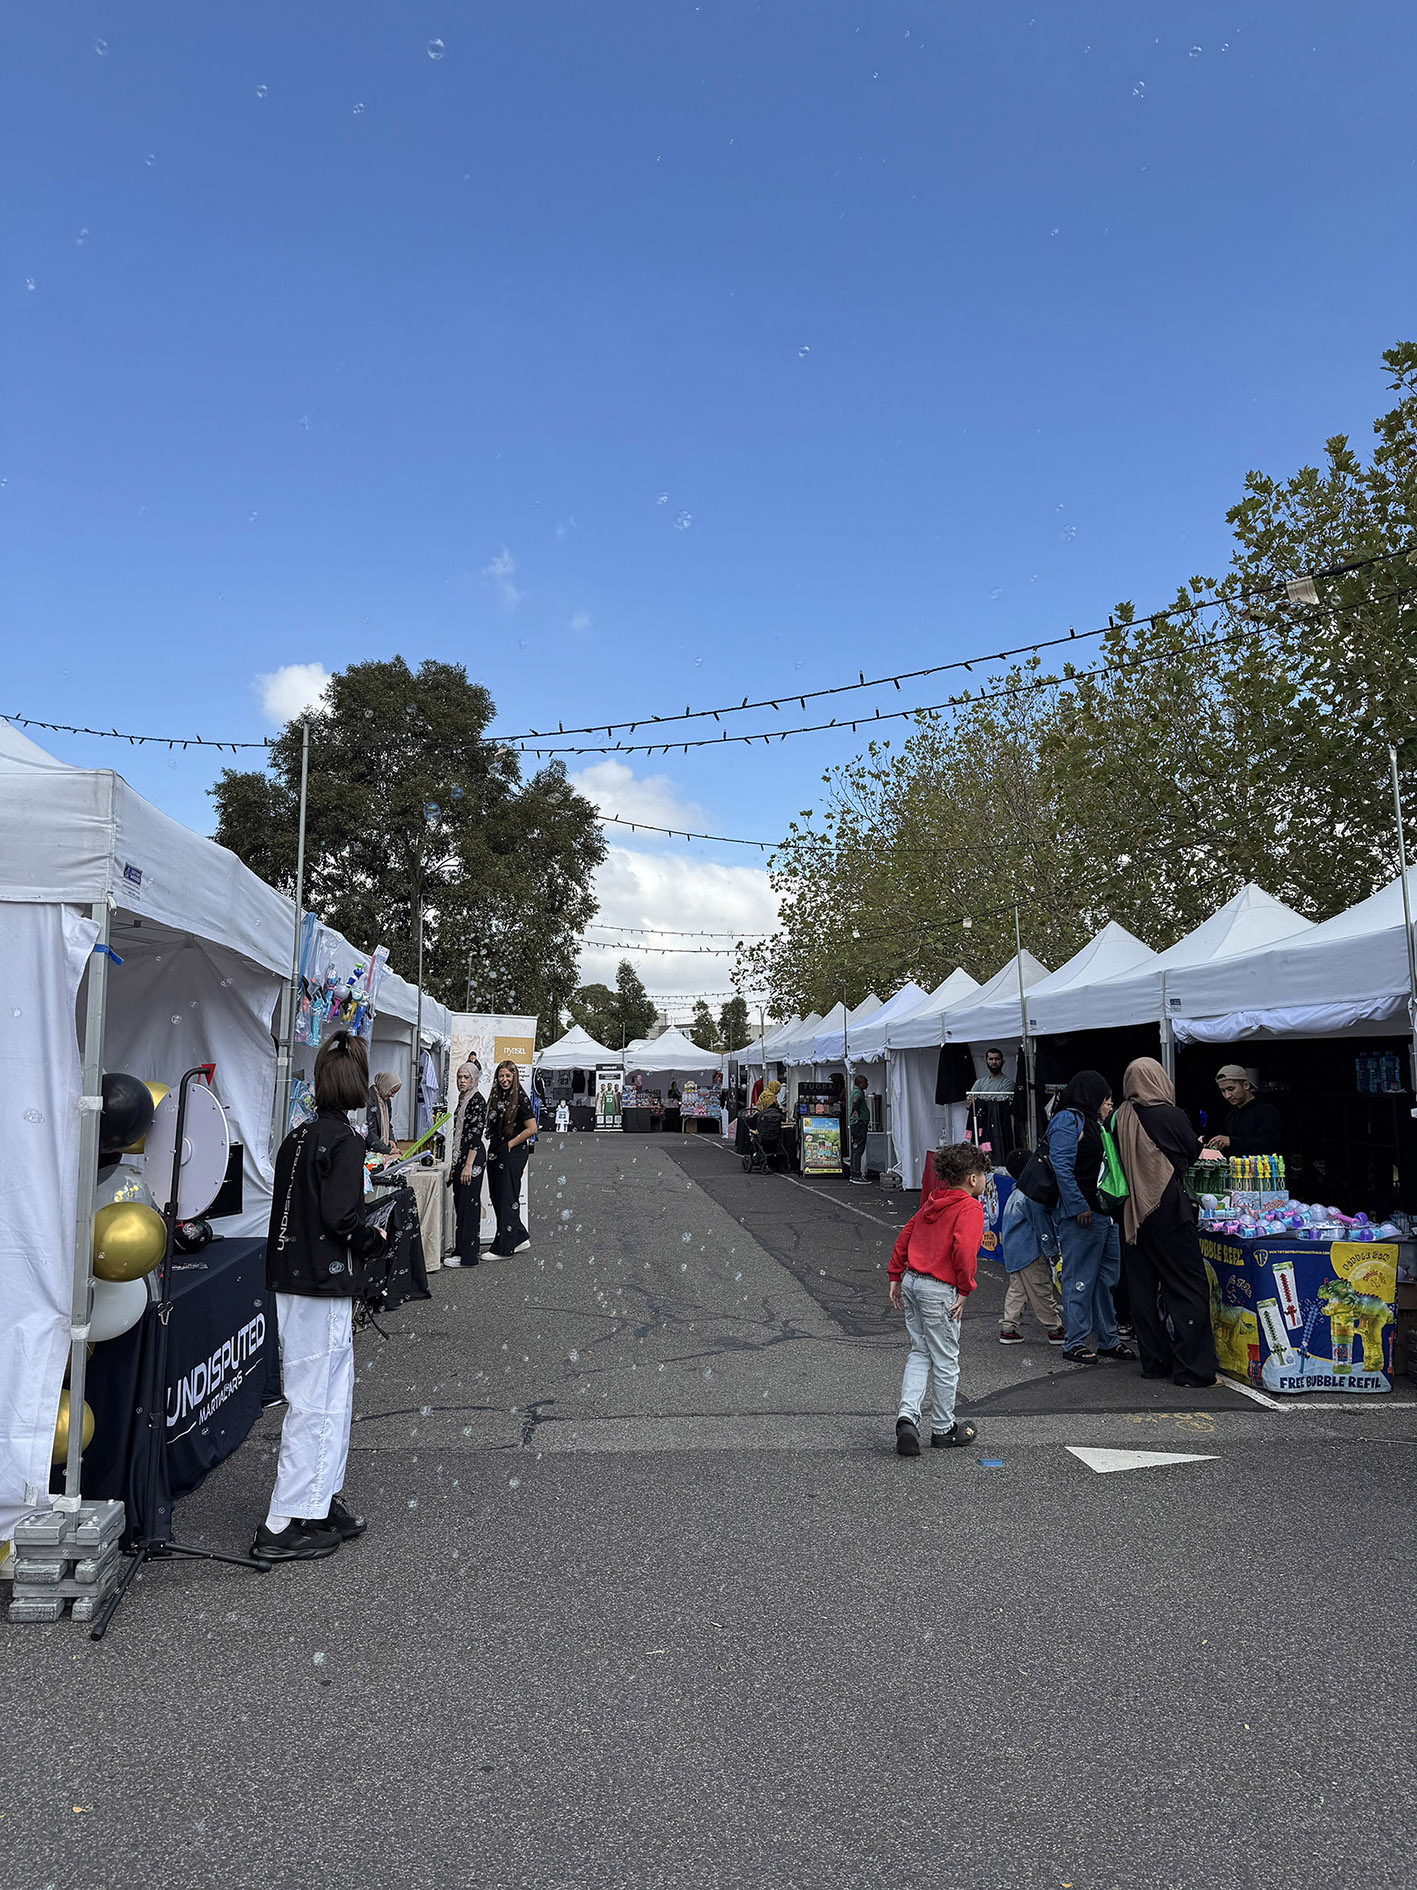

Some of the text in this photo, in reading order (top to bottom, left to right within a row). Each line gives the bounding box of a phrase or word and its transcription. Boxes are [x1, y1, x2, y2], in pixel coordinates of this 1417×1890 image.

[1199, 1238, 1222, 1261] UBBLE
[167, 1312, 265, 1427] UNDISPUTED
[1280, 1375, 1381, 1389] FREE BUBBLE REFIL
[199, 1370, 243, 1425] MARTAL ARS
